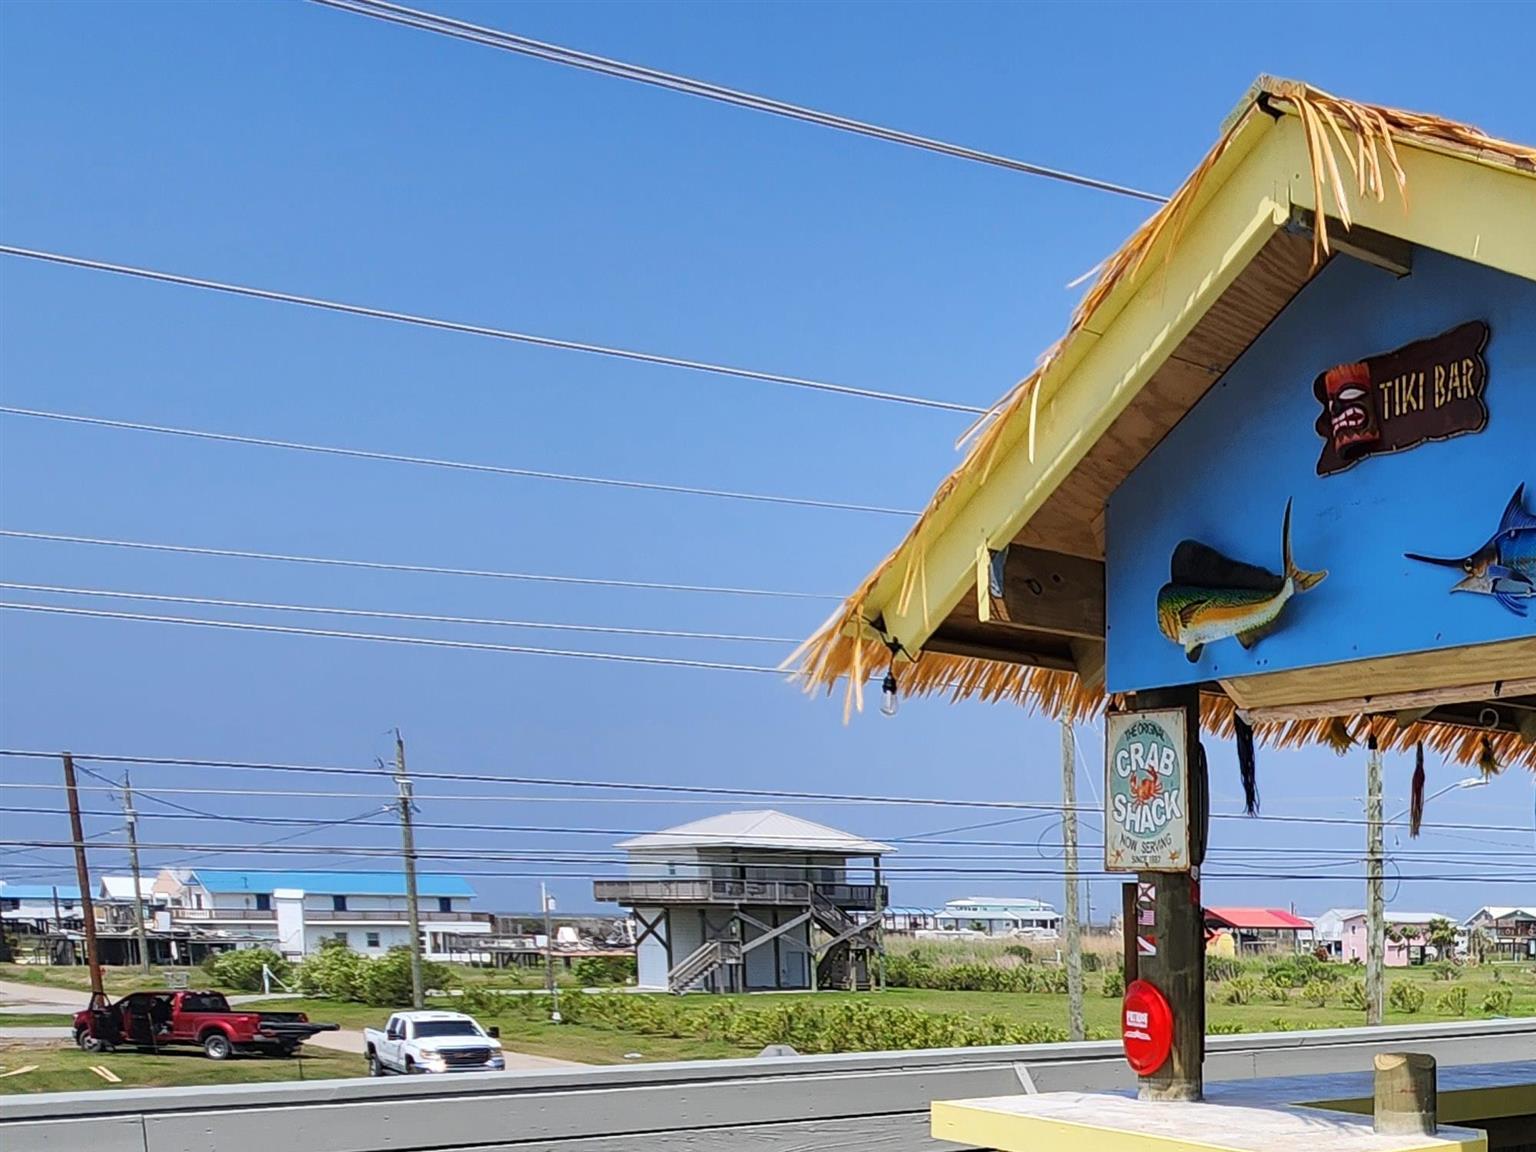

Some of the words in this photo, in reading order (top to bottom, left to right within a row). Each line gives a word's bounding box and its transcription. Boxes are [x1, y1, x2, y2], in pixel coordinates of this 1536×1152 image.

[1379, 372, 1424, 419] TIKI
[1434, 358, 1475, 408] BAR
[1116, 741, 1176, 778] CRAB
[1112, 788, 1183, 833] SHACK
[1119, 833, 1138, 851] NOW
[1140, 832, 1172, 854] SERVING
